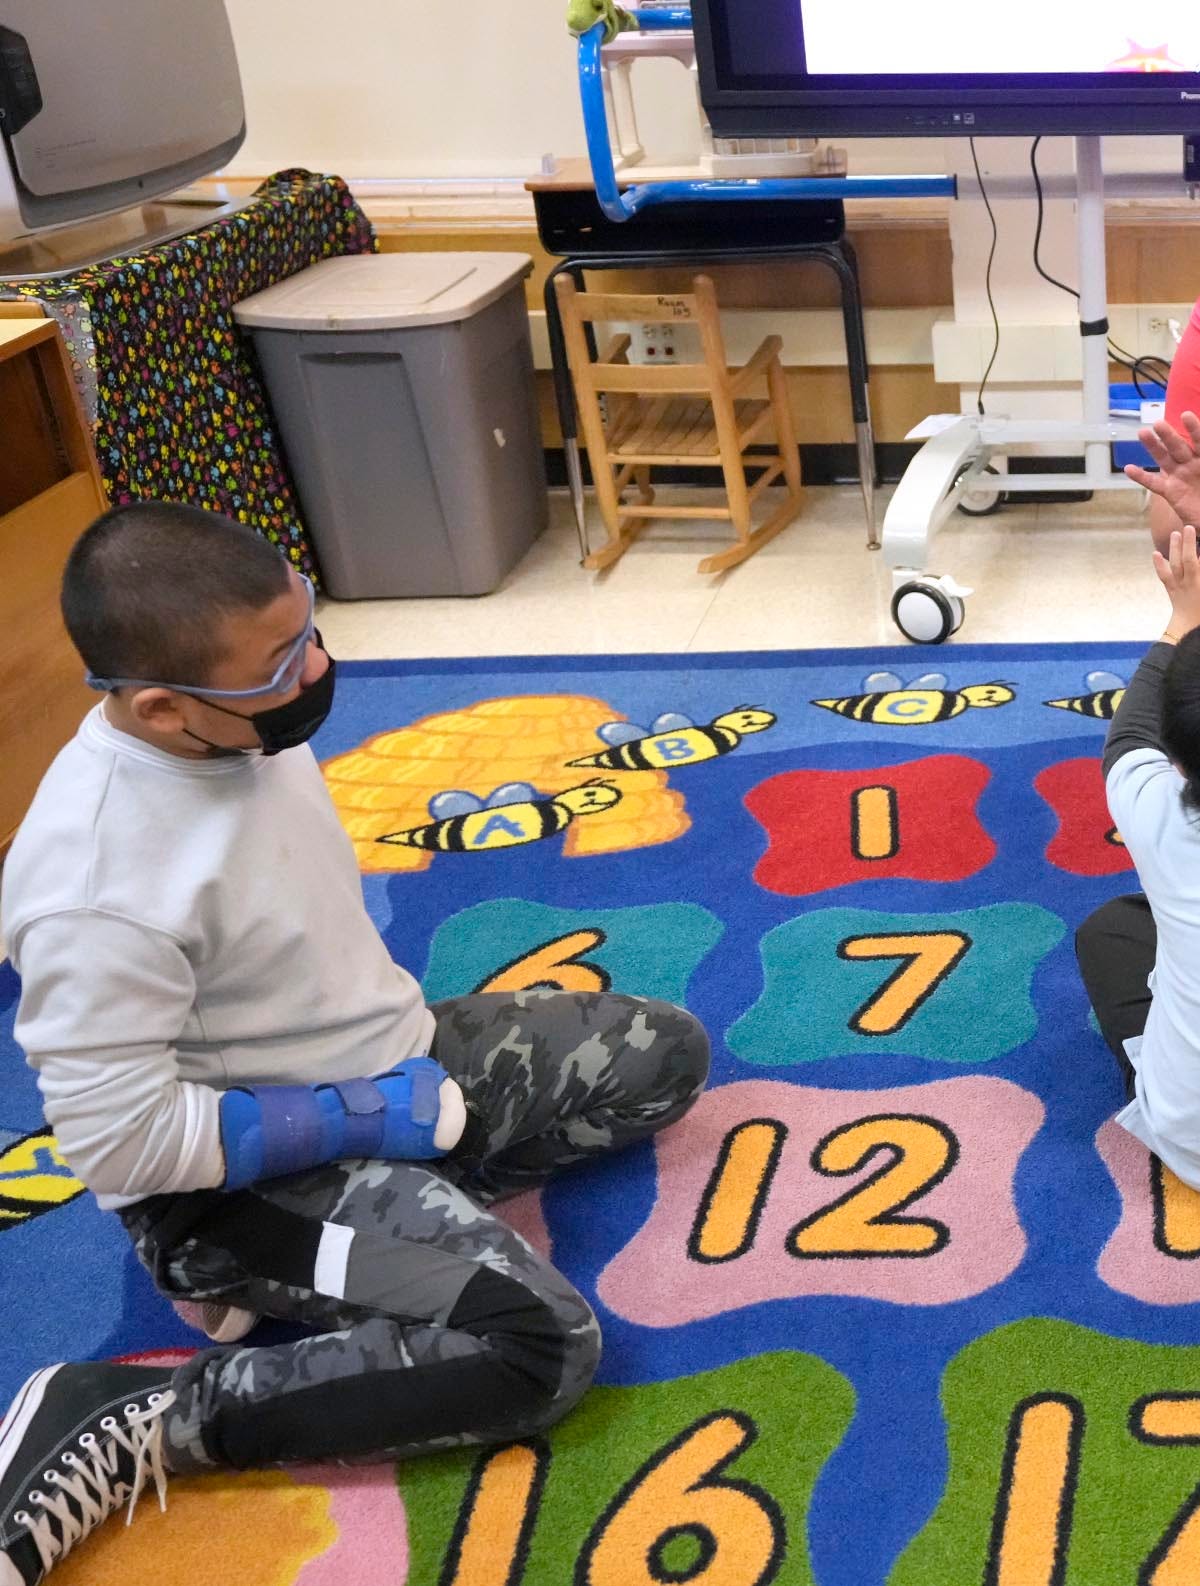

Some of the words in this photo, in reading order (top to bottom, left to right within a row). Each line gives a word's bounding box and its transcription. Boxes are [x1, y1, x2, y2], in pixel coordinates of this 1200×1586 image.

[886, 698, 929, 717] C
[653, 738, 695, 761] B
[472, 814, 526, 845] A
[850, 784, 900, 861] 1
[836, 929, 972, 1037] 7
[688, 1113, 961, 1264] 12
[438, 1408, 788, 1586] 16
